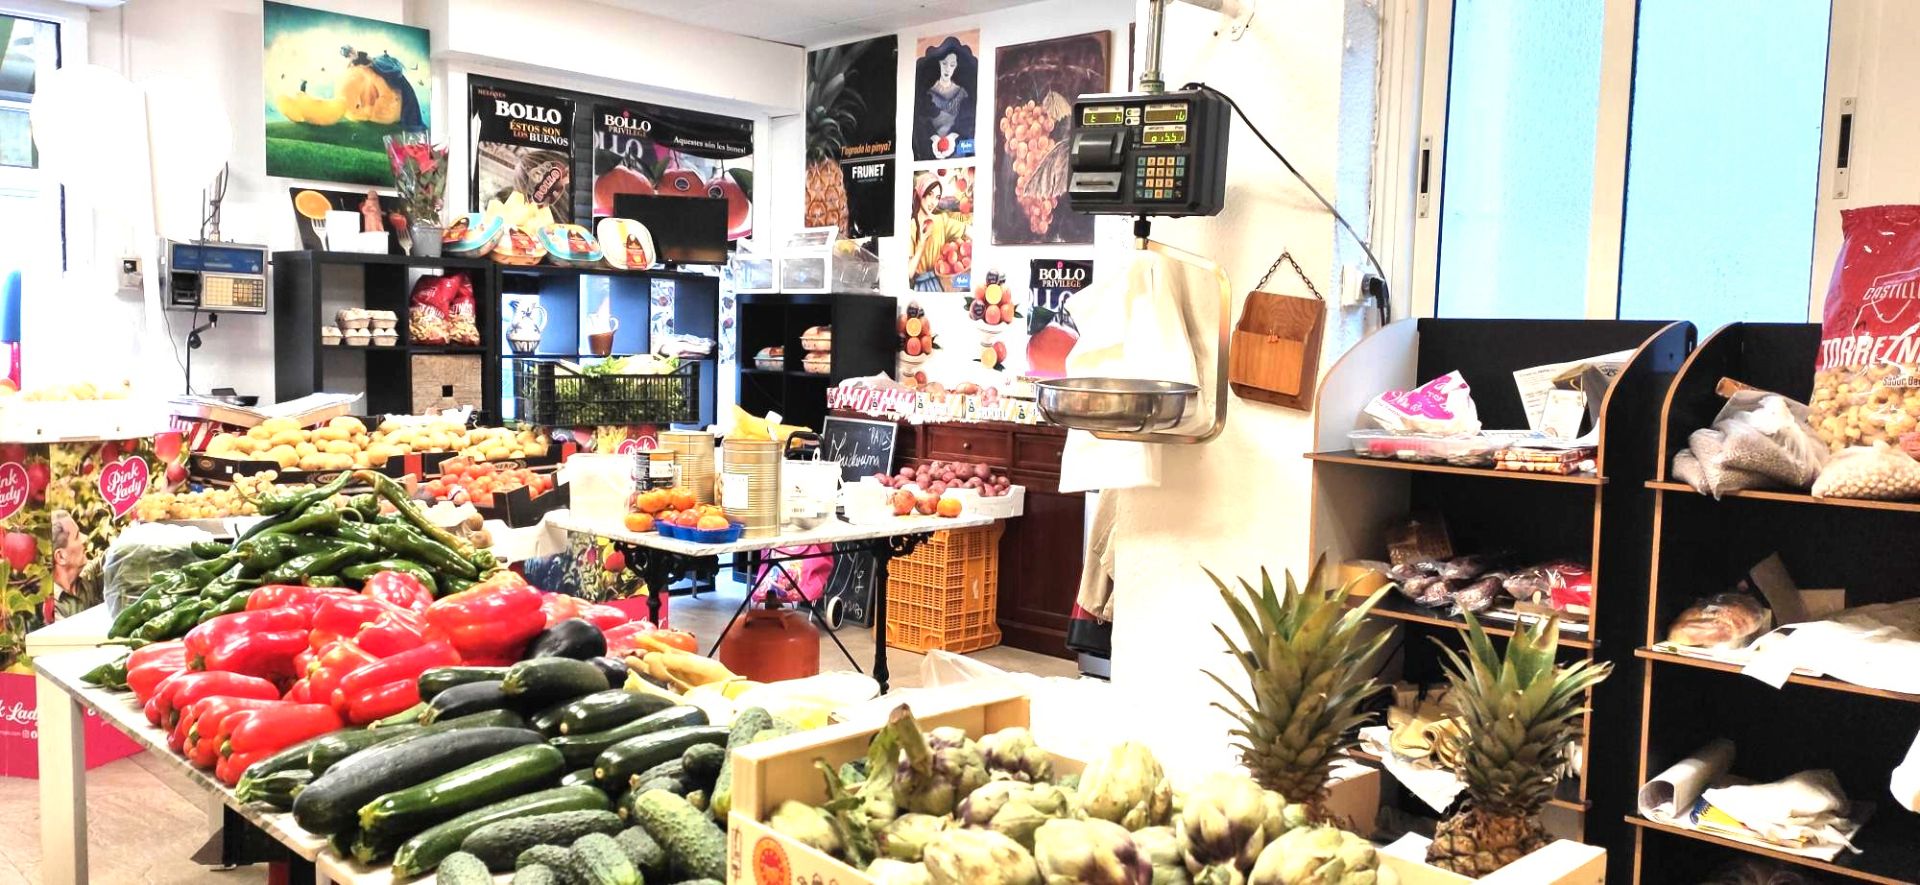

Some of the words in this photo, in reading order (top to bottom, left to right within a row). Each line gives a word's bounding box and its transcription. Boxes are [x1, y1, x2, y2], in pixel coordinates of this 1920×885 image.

[495, 100, 562, 125] BOLLO
[510, 119, 540, 133] ÉSTOS
[542, 126, 561, 136] SON
[604, 114, 652, 132] BOLLO
[513, 130, 529, 139] LOS
[529, 132, 569, 147] BUENOS
[852, 163, 886, 180] FRUNET
[1039, 268, 1086, 281] BOLLO
[1041, 279, 1082, 288] PRIVILEGE
[1863, 281, 1920, 300] CASTILL
[1821, 332, 1920, 369] TORREZN
[0, 468, 18, 486] nk
[107, 462, 140, 492] Pink
[111, 480, 142, 504] Lady
[6, 702, 38, 727] Lad
